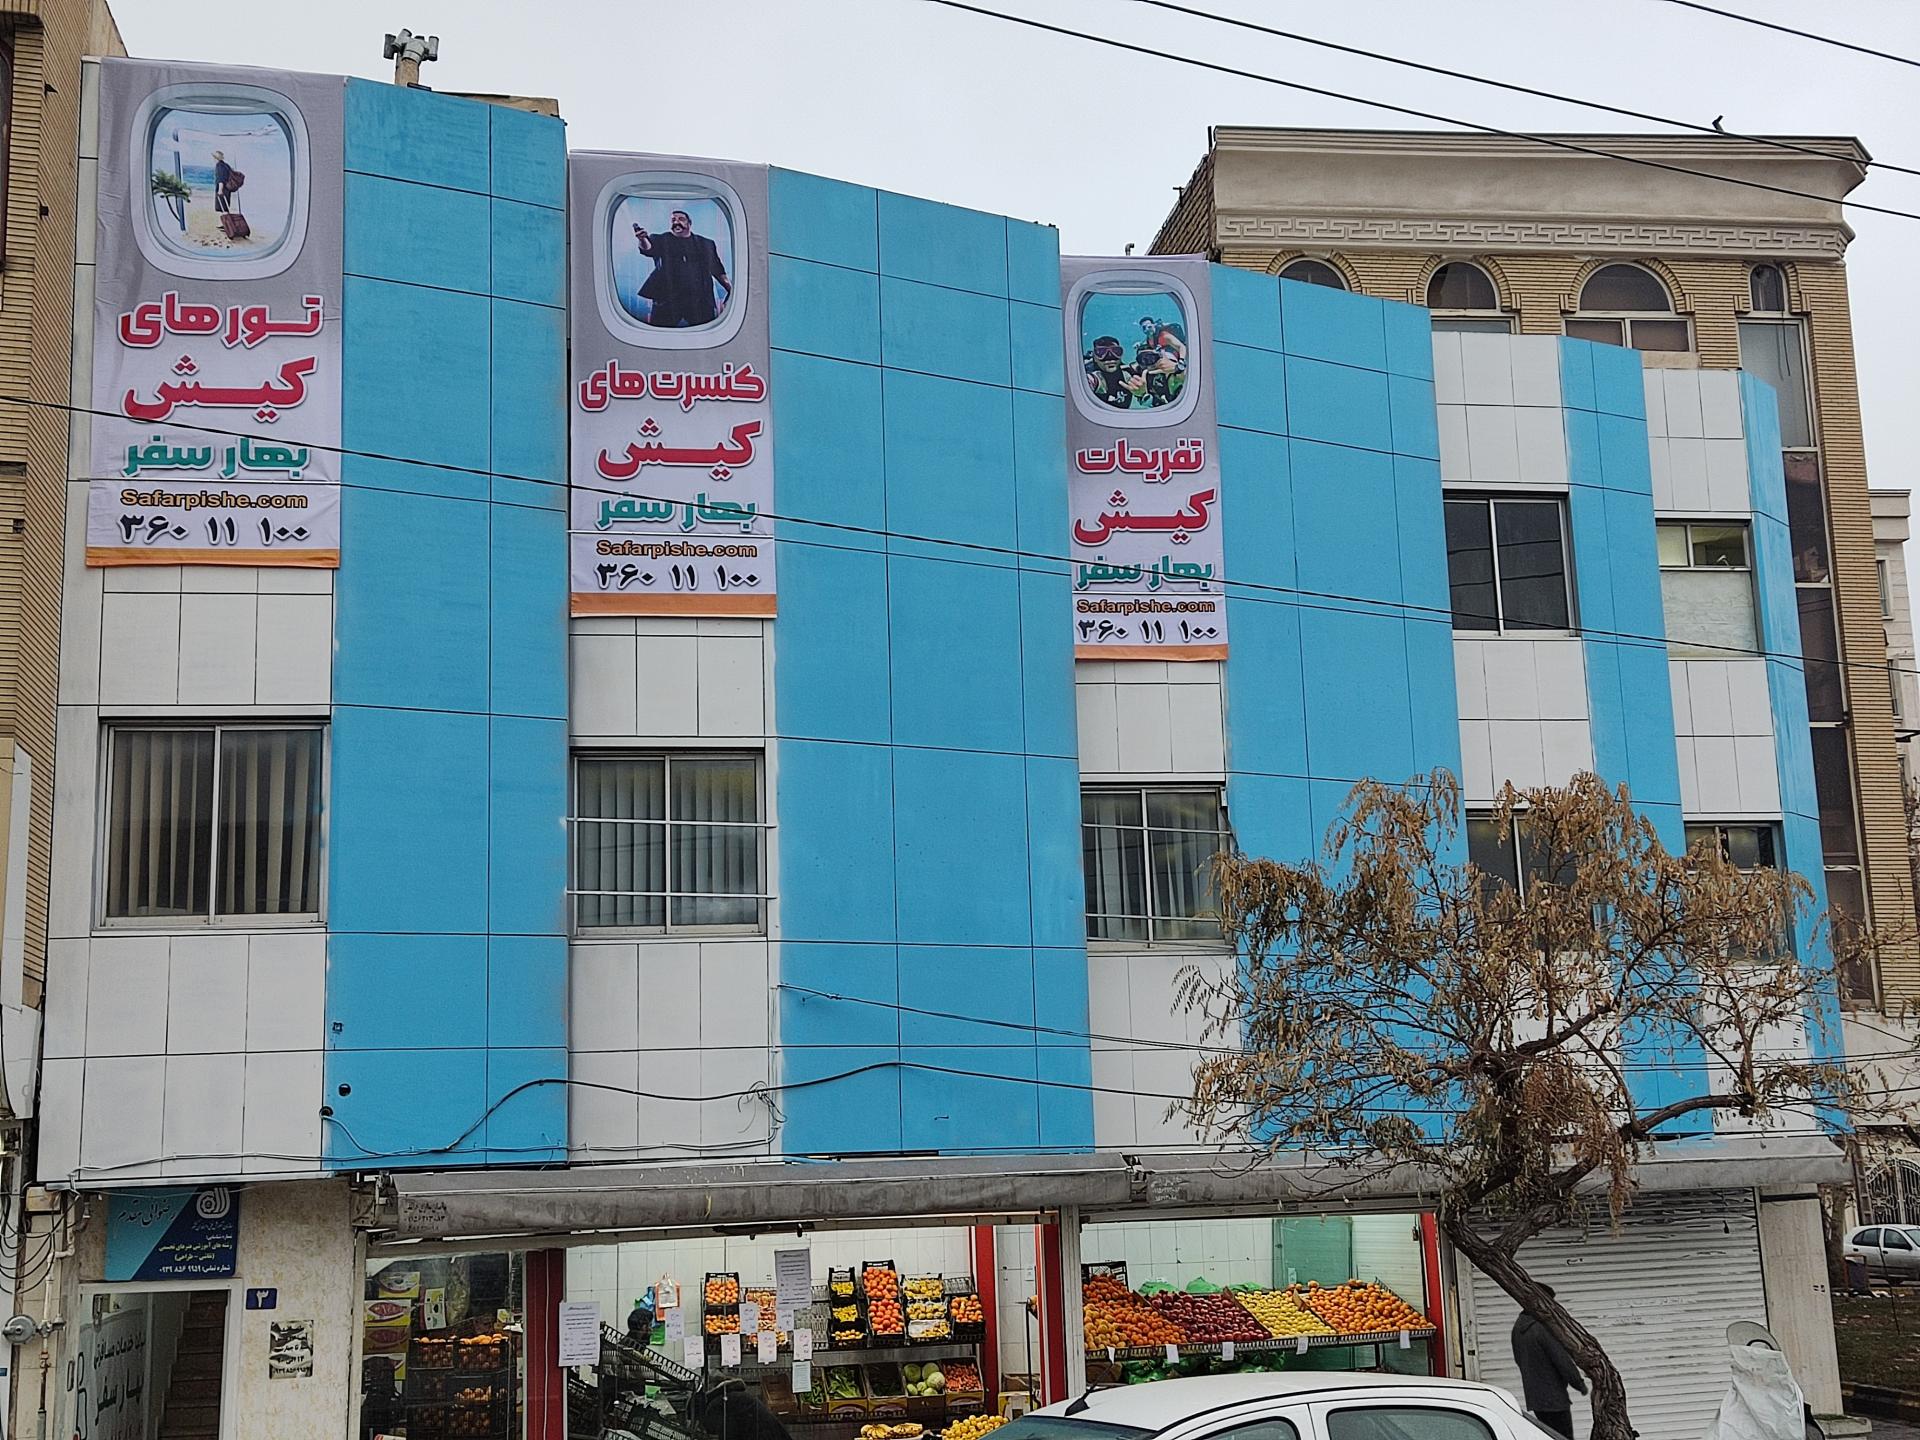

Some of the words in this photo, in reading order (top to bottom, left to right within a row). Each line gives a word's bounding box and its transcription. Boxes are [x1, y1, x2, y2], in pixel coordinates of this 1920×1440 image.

[122, 353, 317, 422] کیش
[122, 434, 213, 477] سفر
[221, 436, 309, 478] بهار
[597, 416, 763, 480] کیش
[1076, 438, 1204, 482] تفریحات
[120, 488, 309, 511] Safarpishe.com
[596, 491, 674, 530] سفر
[681, 491, 757, 531] بهار
[1073, 488, 1217, 544] کیش
[119, 513, 187, 542] ۳۶۰
[205, 515, 237, 543] ۱۱
[259, 516, 309, 543] ۱۰۰
[596, 539, 758, 560] Safarpishe.com
[596, 562, 655, 589] ۳۶۰
[671, 563, 698, 589] ۱۱
[716, 564, 759, 589] ۱۰۰
[1075, 554, 1142, 591] سفر
[1148, 554, 1214, 591] بهار
[1076, 598, 1216, 616] Safarpishe.com
[1077, 618, 1128, 642] ۳۶۰
[1140, 618, 1165, 642] ۱۱
[1179, 619, 1218, 642] ۱۰۰
[216, 1264, 231, 1273] شماره
[256, 1290, 269, 1308] ۳
[94, 1375, 119, 1427] سفر
[118, 1367, 146, 1414] بهار
